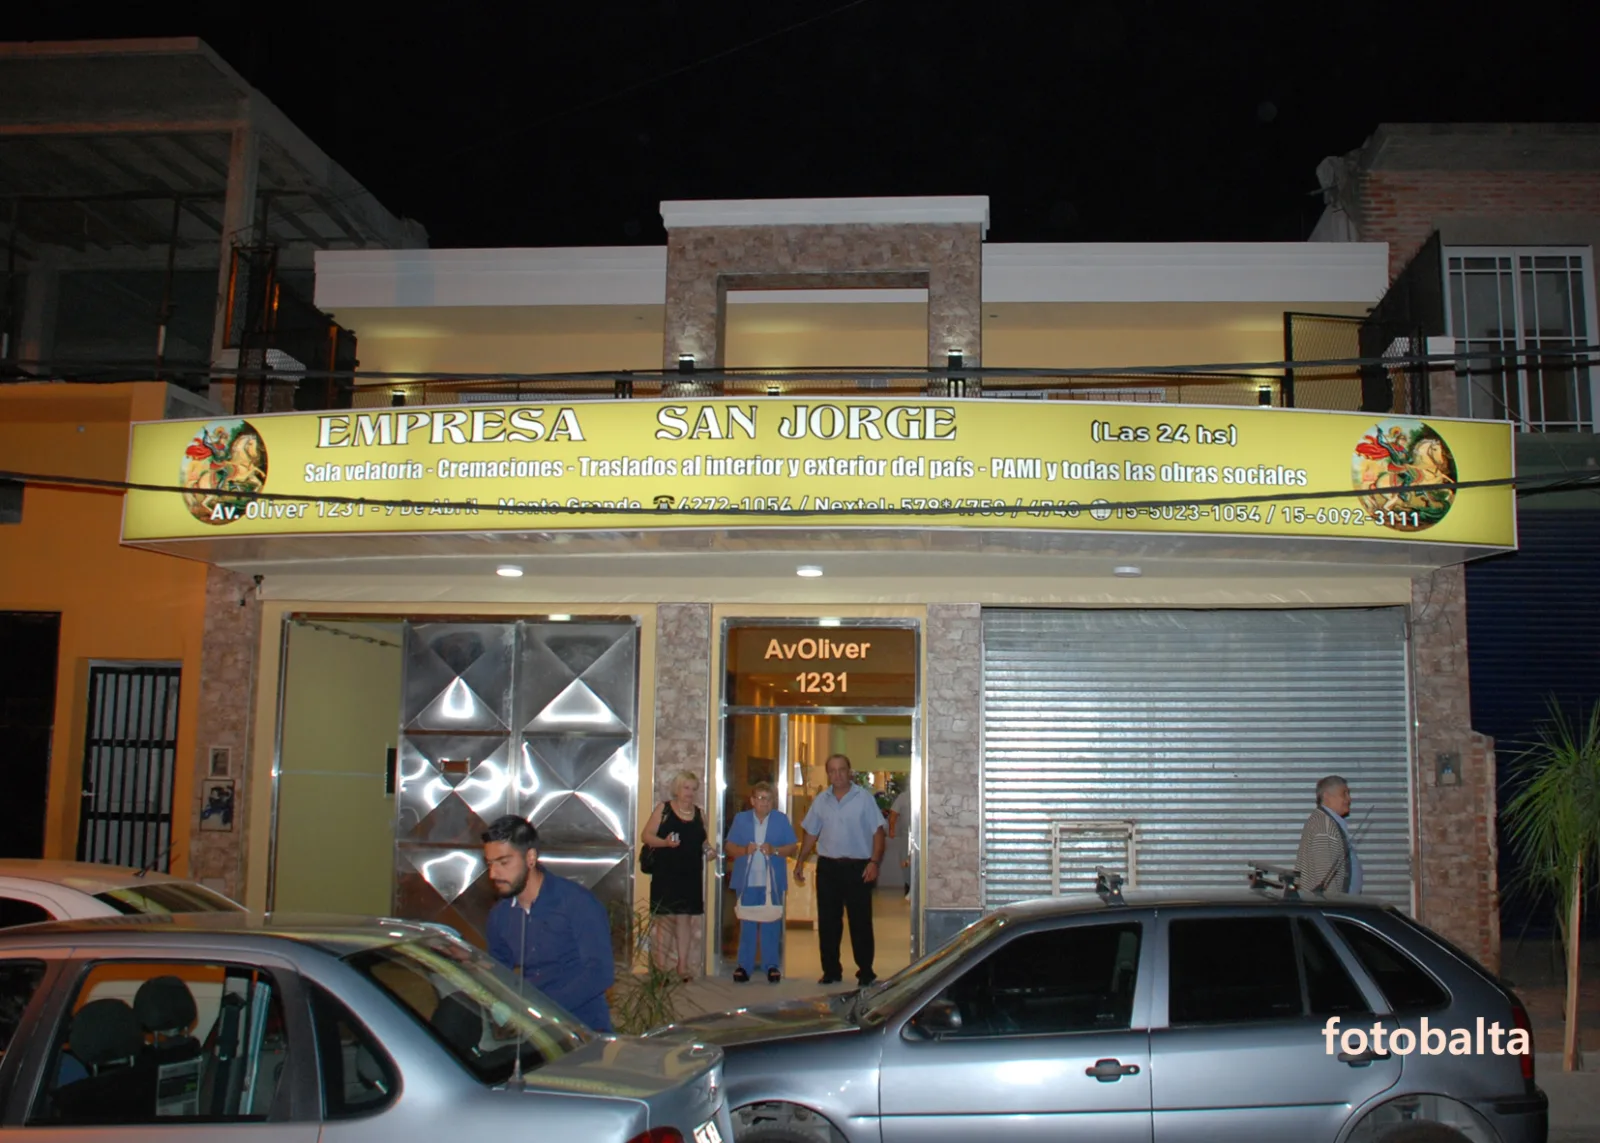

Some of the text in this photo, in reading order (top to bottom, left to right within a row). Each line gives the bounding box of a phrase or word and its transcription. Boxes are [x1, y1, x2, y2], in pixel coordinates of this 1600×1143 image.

[316, 404, 957, 448] EMPRESA SAN JORGE
[1091, 420, 1237, 447] (Las 24 hs)
[304, 462, 341, 483] Sala
[344, 461, 423, 482] velatoria
[437, 458, 563, 479] Cremaciones
[578, 456, 677, 478] Traslados
[682, 455, 701, 476] al
[705, 455, 784, 476] interior
[788, 462, 799, 478] y
[804, 455, 887, 477] exterior
[891, 456, 924, 477] del
[929, 457, 975, 479] país
[991, 457, 1041, 479] PAMI
[1046, 463, 1058, 481] y
[1062, 460, 1120, 482] todas
[1124, 460, 1156, 482] las
[1160, 462, 1219, 484] obras
[1222, 464, 1308, 487] sociales
[210, 501, 239, 520] Av.
[245, 500, 308, 519] Oliver
[316, 500, 365, 518] 1231
[1281, 505, 1419, 527] 15-6092-3111
[796, 671, 847, 693] 1231
